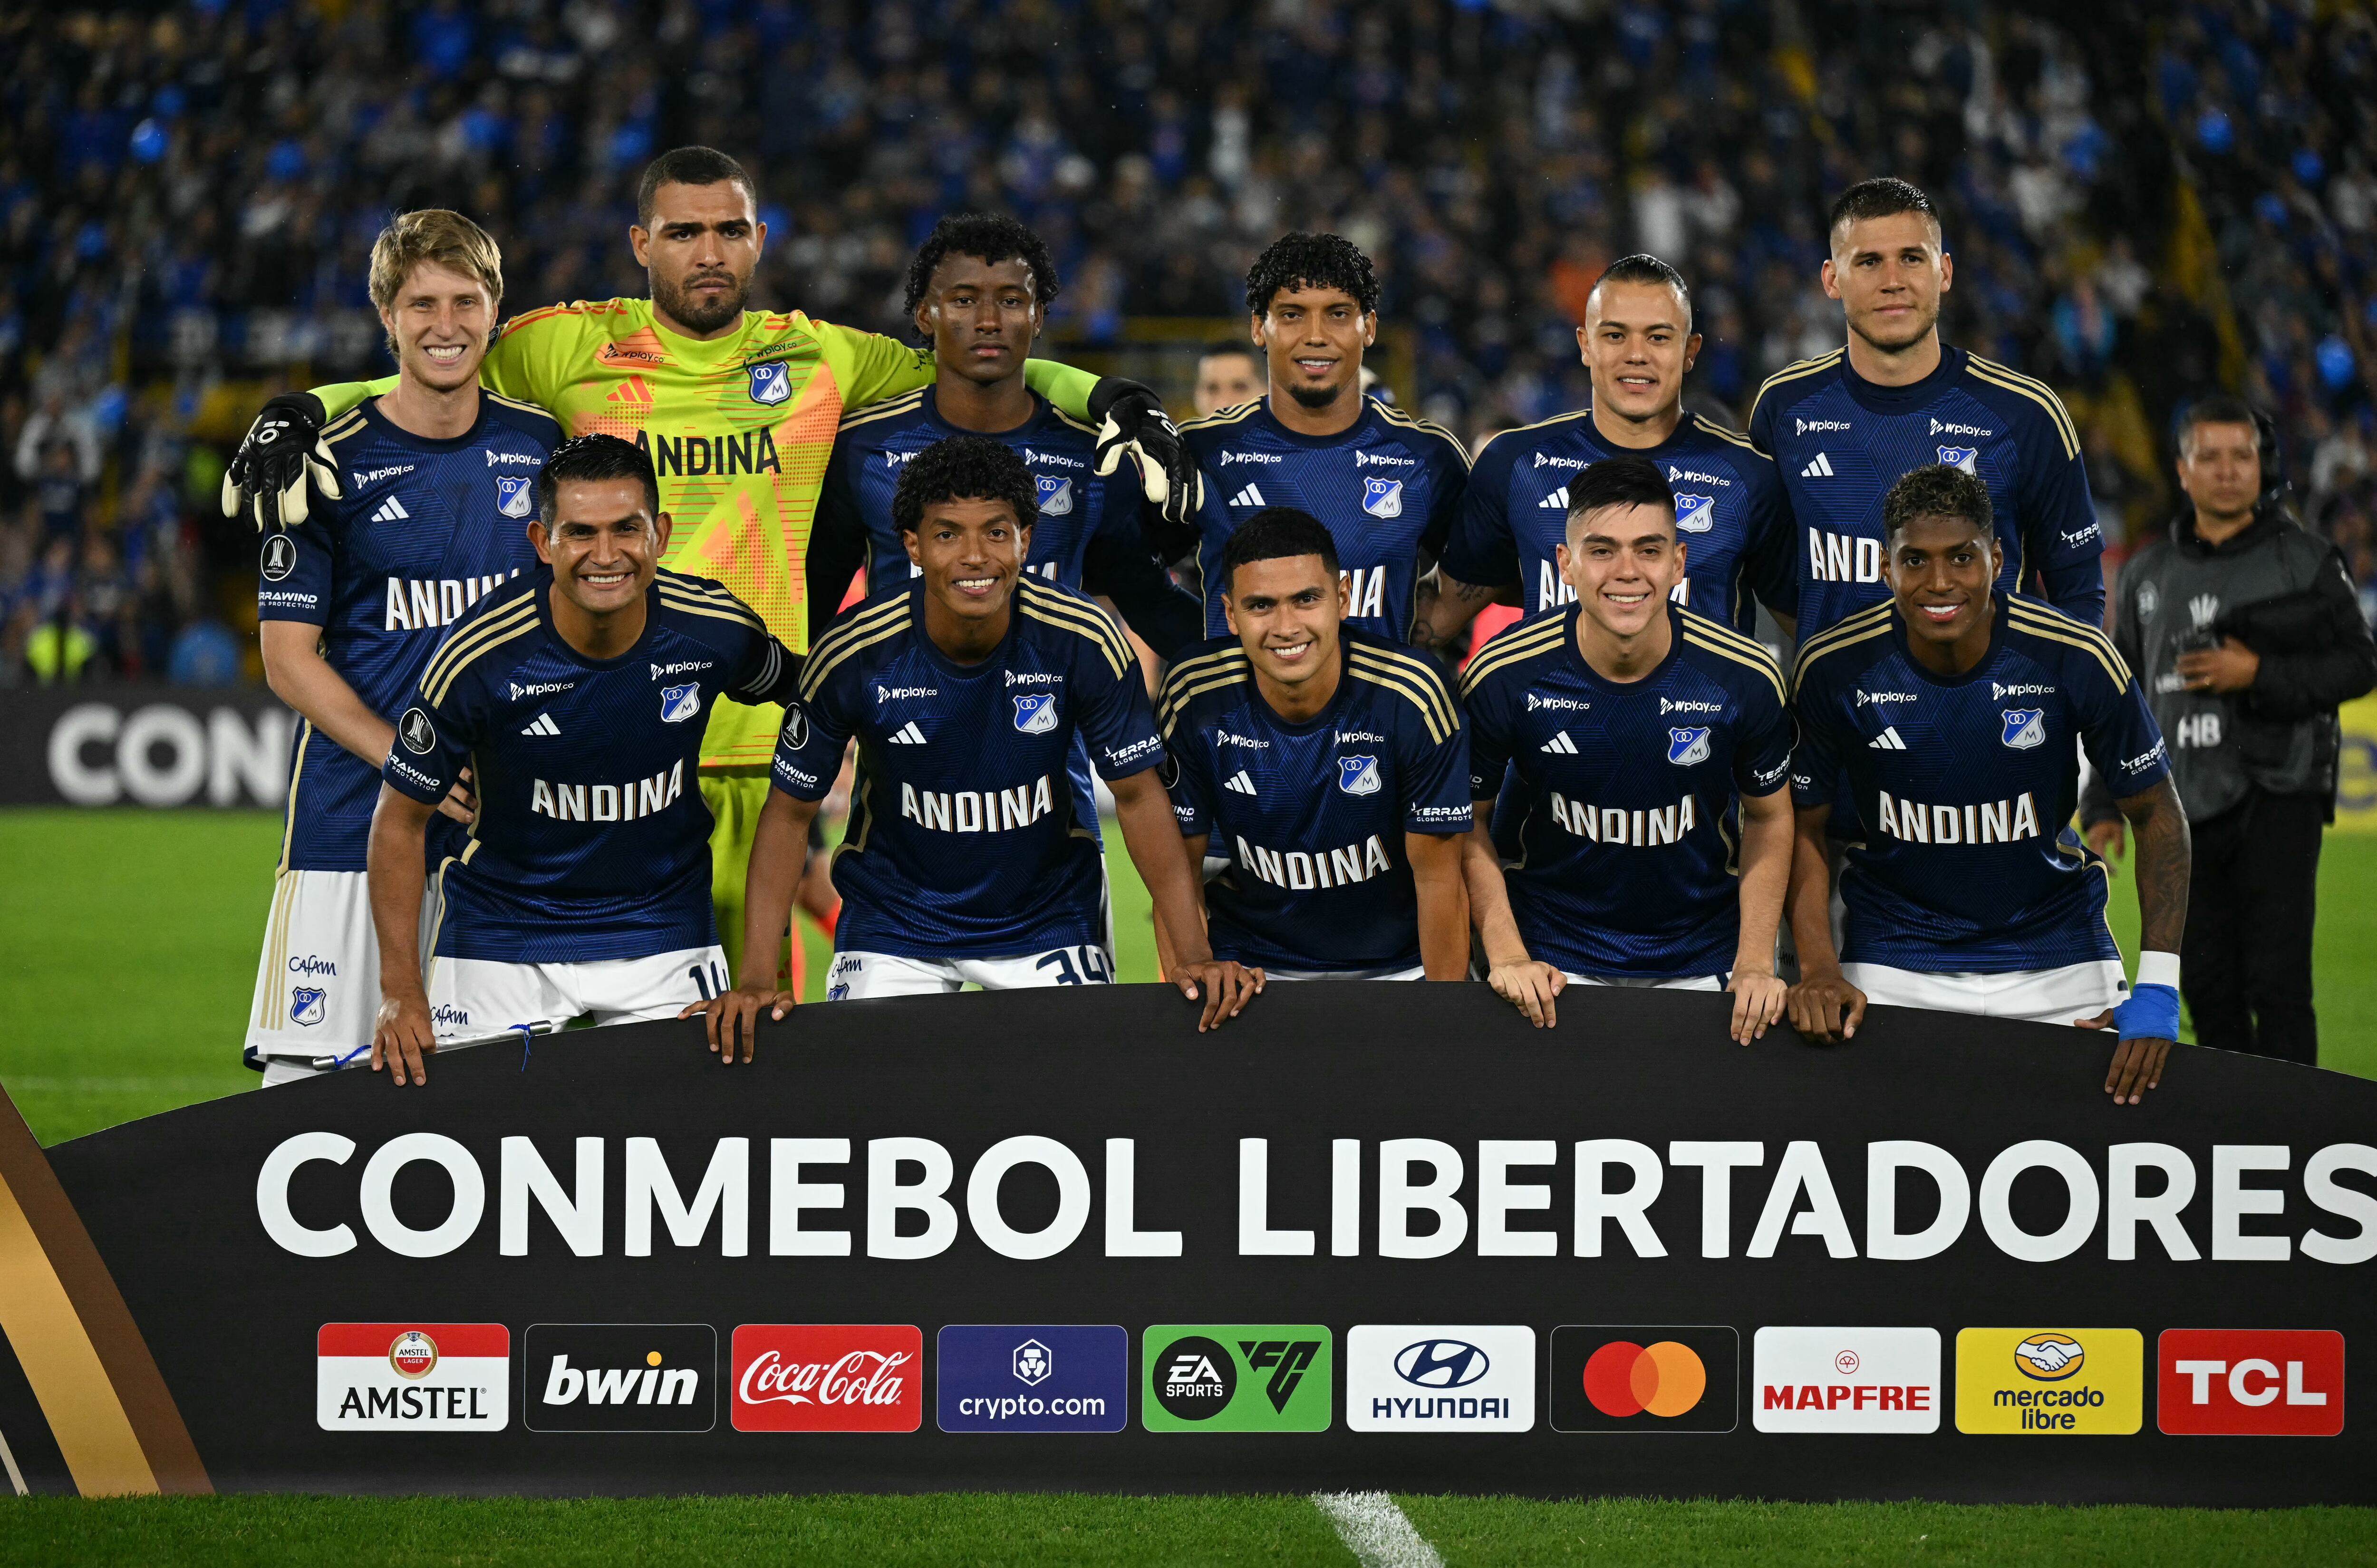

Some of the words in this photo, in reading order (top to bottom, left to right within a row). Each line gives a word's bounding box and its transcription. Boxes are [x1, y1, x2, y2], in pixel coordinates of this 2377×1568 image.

[1809, 420, 1850, 432] Wplay.co
[1945, 422, 1992, 437] Wplay.co
[500, 453, 541, 465] Wplay.co
[1040, 453, 1084, 468] Wplay.co
[1236, 452, 1282, 464] Wplay.co
[1370, 455, 1415, 467] Wplay.co
[1549, 456, 1591, 470] Wplay.c
[369, 464, 414, 481] Wplay.co
[1684, 470, 1730, 487] Wplay.co
[1809, 526, 1882, 583] AND
[268, 601, 316, 610] PROTECTION
[666, 661, 713, 674] Wplay.co
[1017, 672, 1063, 685] Wplay.co
[526, 682, 574, 694] Wplay.co
[892, 687, 937, 700] Wplay.co
[2008, 683, 2055, 695] Wplay.co
[1543, 697, 1590, 711] Wplay.co
[1872, 692, 1917, 704] Wplay.co
[1675, 700, 1722, 713] Wplay.co
[1342, 731, 1384, 744] Wplay.co
[2177, 713, 2222, 749] HB
[1231, 734, 1269, 750] Wplay.co
[1114, 753, 1143, 766] GLOBAL
[2131, 761, 2156, 775] GLOBAL
[392, 766, 436, 791] PROTECTION
[774, 765, 814, 789] PROTECTION
[1760, 773, 1783, 786] GLOBAL
[532, 757, 684, 822] ANDINA
[902, 774, 1053, 832] ANDINA
[1550, 792, 1695, 847] ANDINA
[1880, 791, 2041, 844] ANDINA
[1237, 834, 1392, 890] ANDINA
[1036, 945, 1110, 985] 34
[256, 1131, 1183, 1260] CONMEBOL
[1238, 1137, 2377, 1265] LIBERTADORES
[1167, 1355, 1222, 1383] EA
[542, 1351, 698, 1405] bwin
[739, 1350, 914, 1405] Coca-Cola
[2175, 1358, 2327, 1406] TCL
[1167, 1384, 1223, 1397] SPORTS
[1764, 1385, 1930, 1411] MAPFRE
[1994, 1385, 2105, 1407] mercado
[959, 1394, 1105, 1419] crypto.com
[1372, 1398, 1508, 1419] HYUNDAI
[2022, 1408, 2076, 1430] libre
